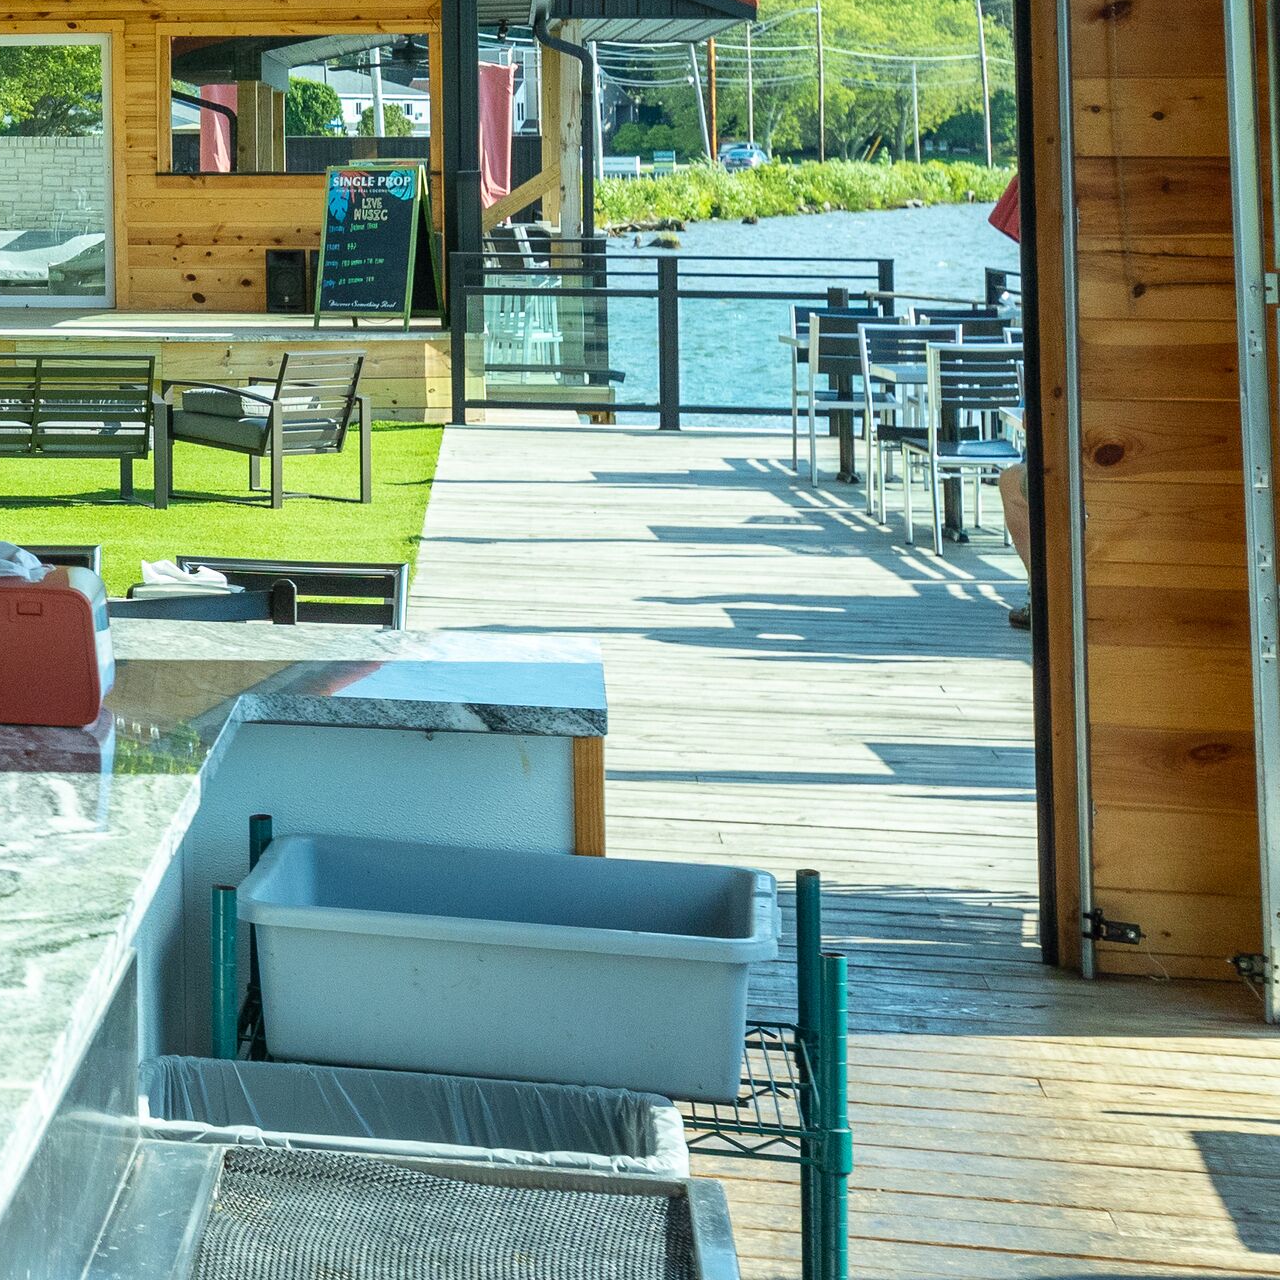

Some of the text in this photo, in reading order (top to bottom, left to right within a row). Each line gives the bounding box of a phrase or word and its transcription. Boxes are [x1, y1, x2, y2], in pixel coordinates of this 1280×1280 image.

[332, 176, 411, 187] SINGLE PROP
[361, 197, 383, 209] LIVE
[353, 209, 388, 221] MUSIC
[351, 299, 380, 309] Something
[381, 300, 396, 308] Real
